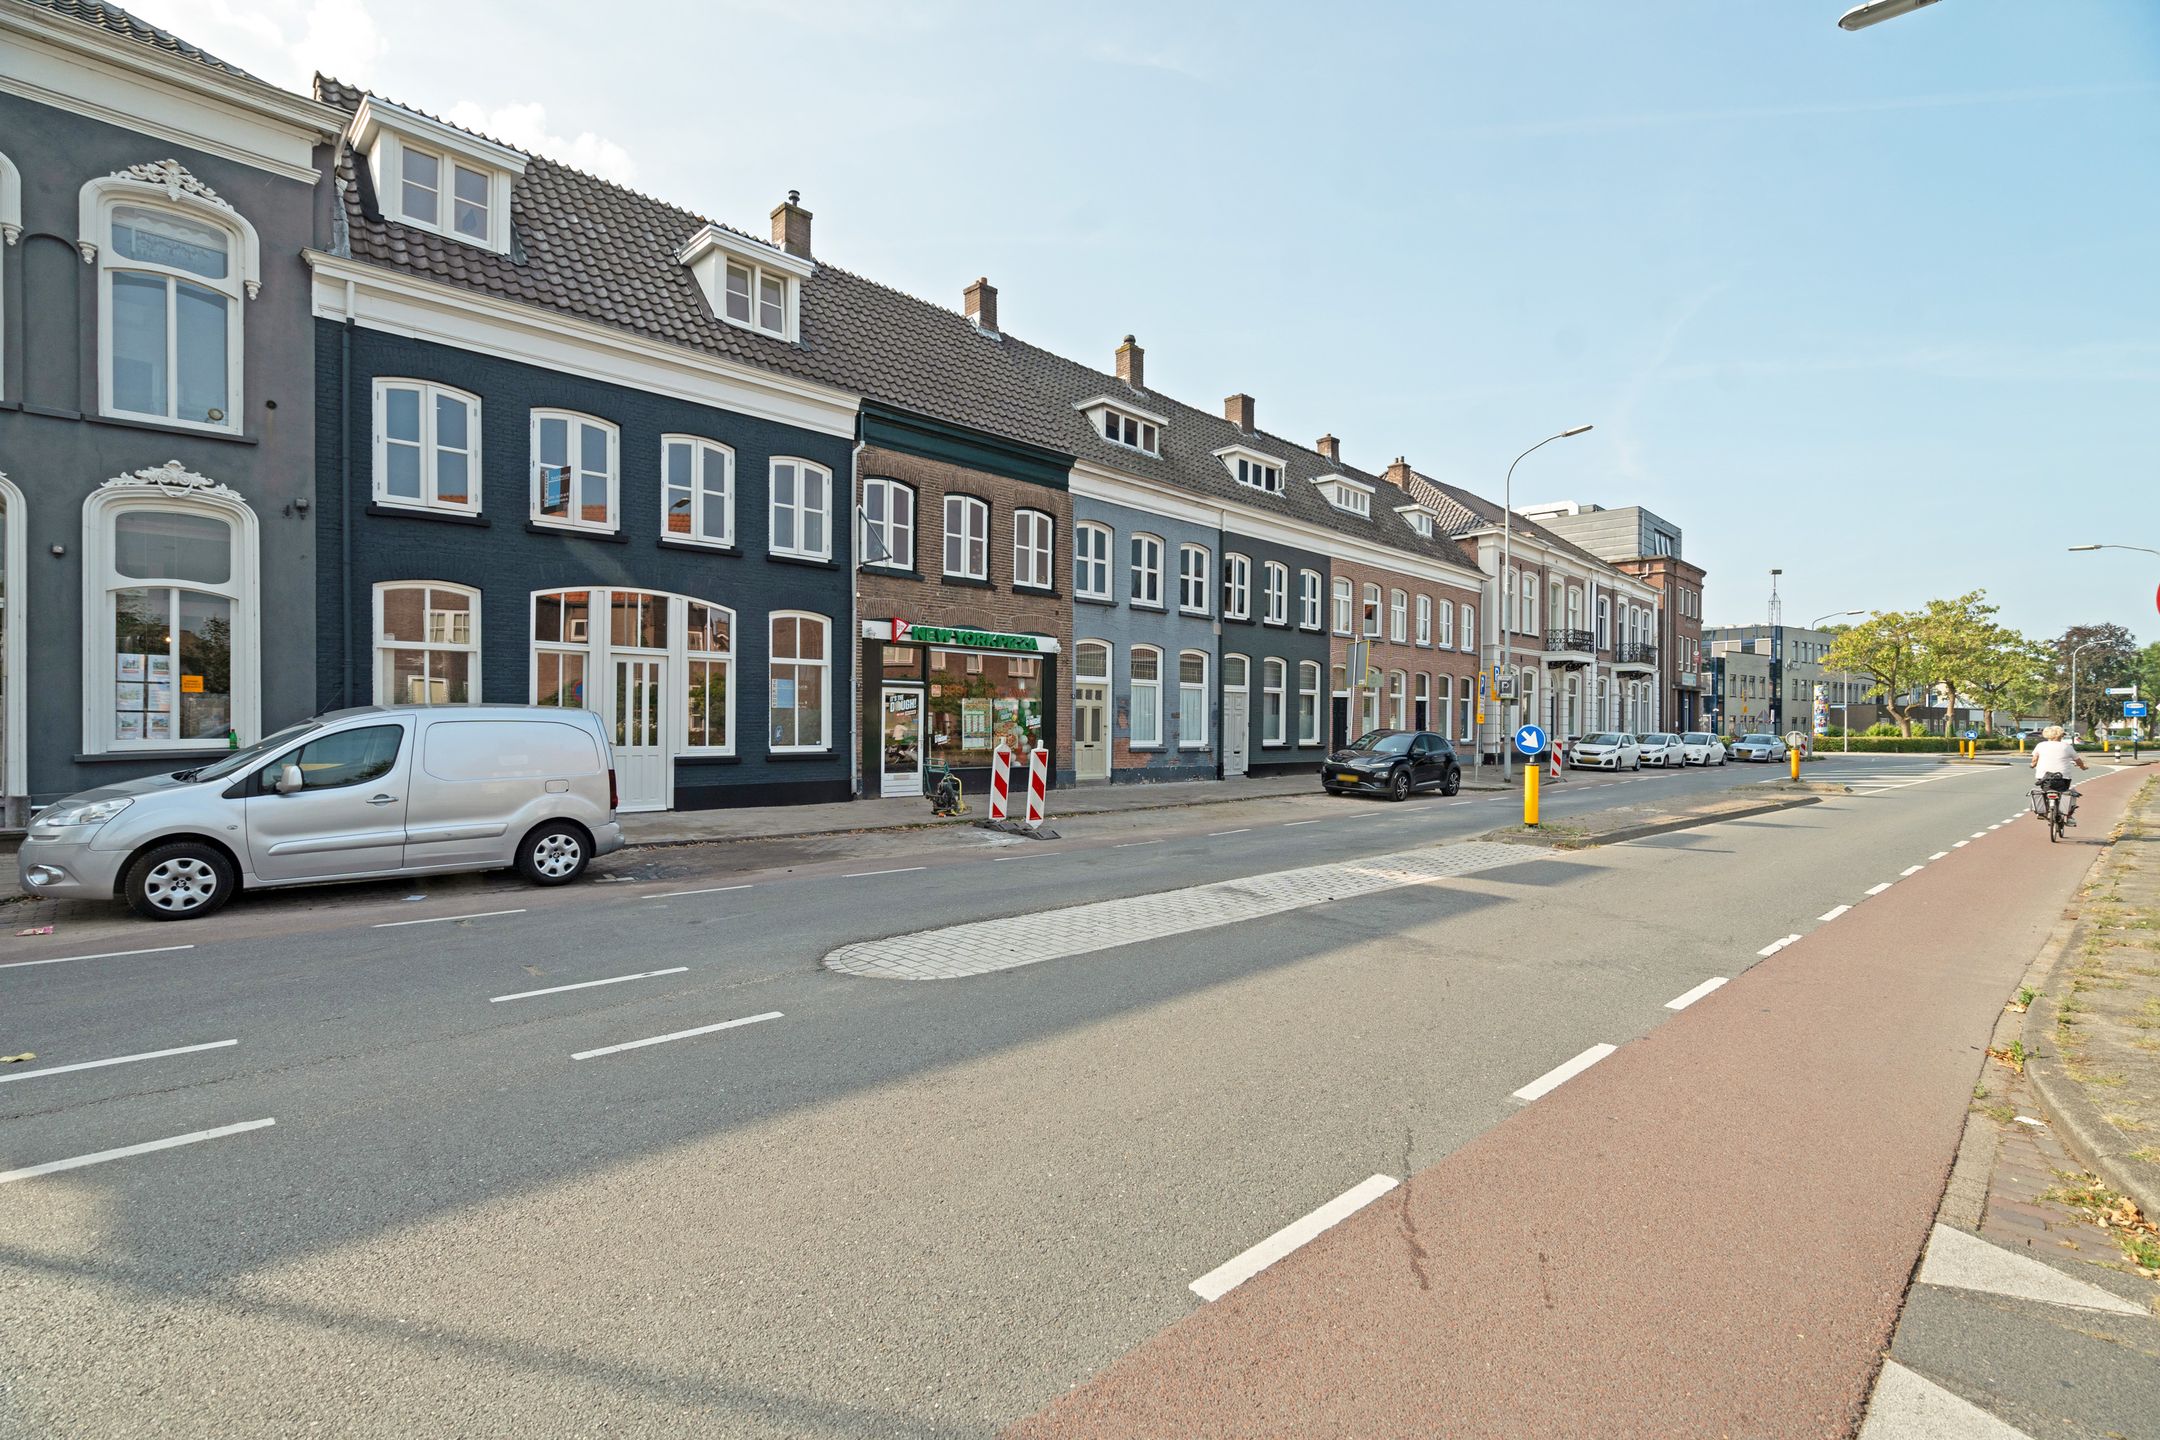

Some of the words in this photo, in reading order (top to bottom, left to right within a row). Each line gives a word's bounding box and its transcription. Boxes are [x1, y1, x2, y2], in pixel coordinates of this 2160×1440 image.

[912, 626, 952, 643] NEW
[954, 629, 997, 647] YORK
[997, 635, 1038, 650] PIZZA
